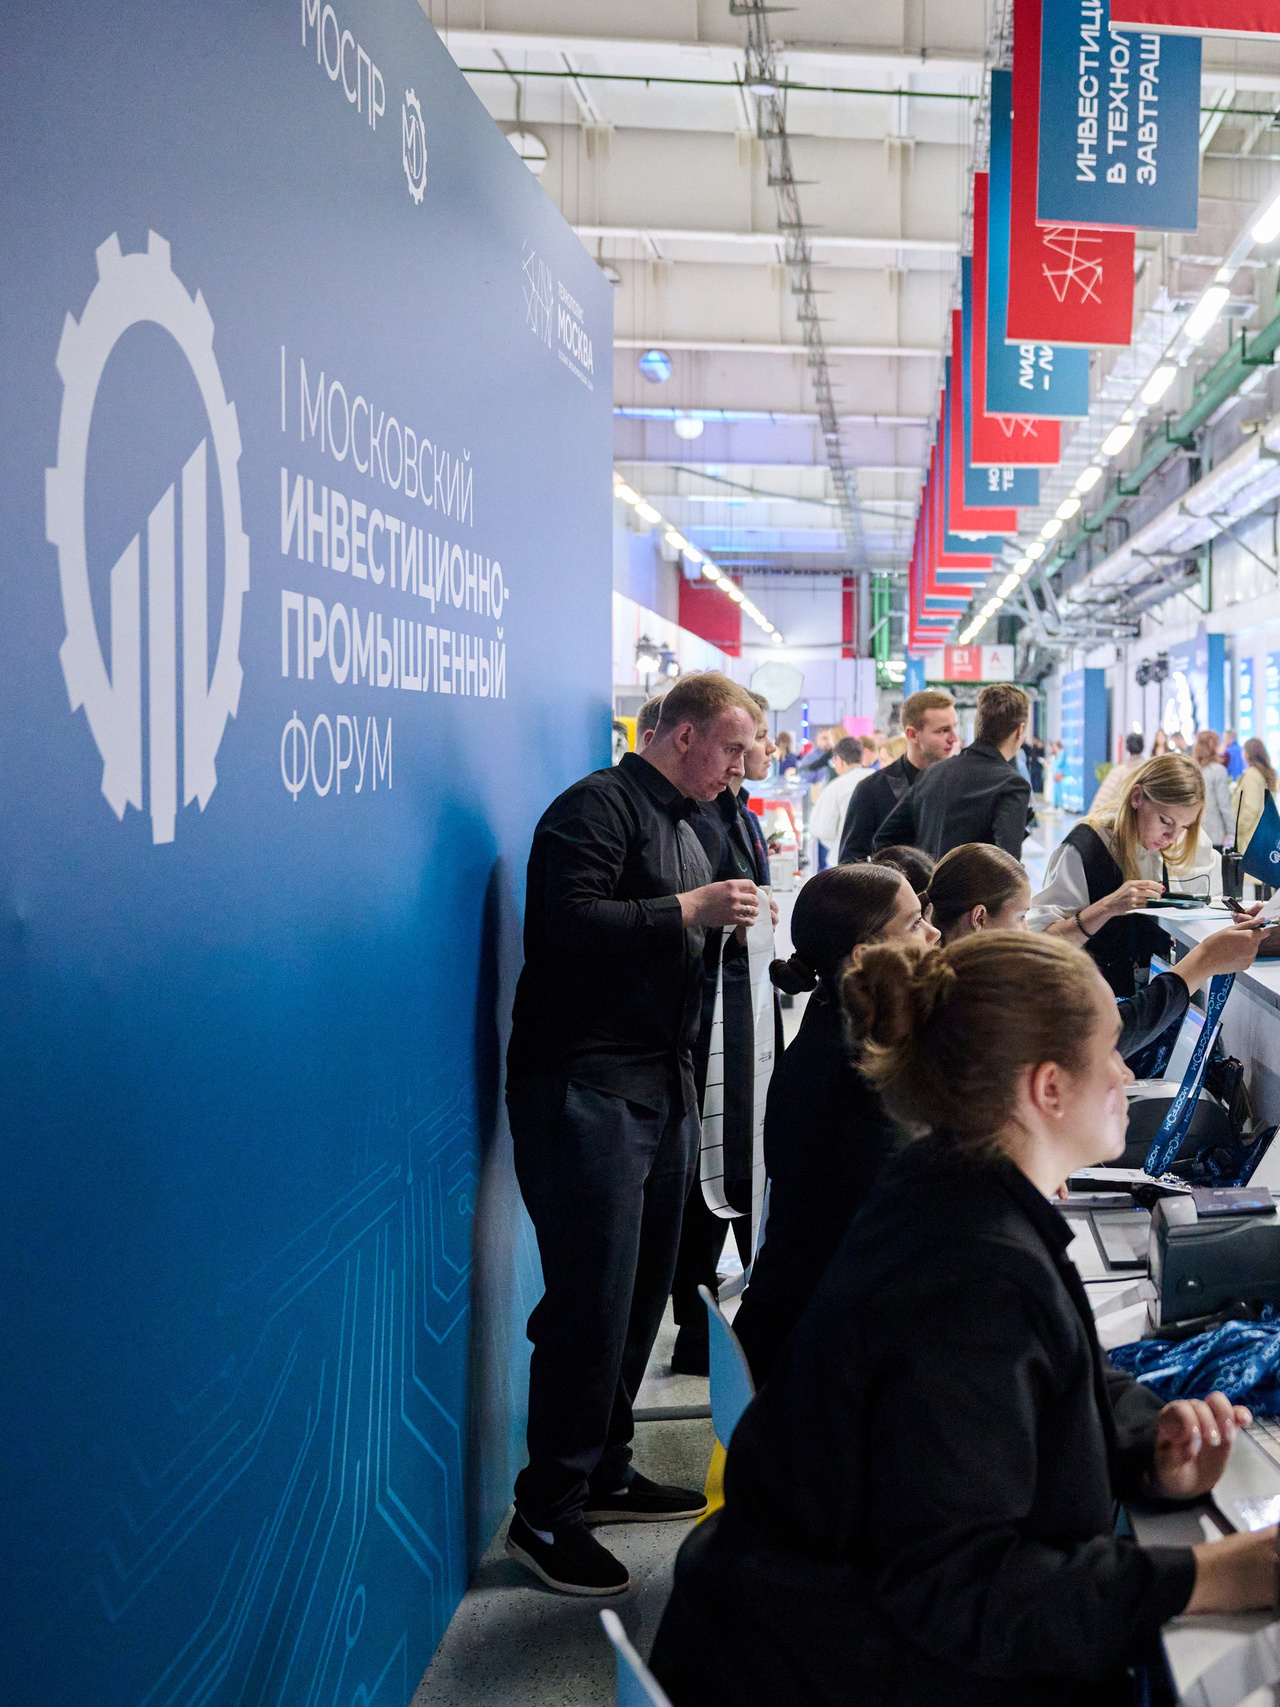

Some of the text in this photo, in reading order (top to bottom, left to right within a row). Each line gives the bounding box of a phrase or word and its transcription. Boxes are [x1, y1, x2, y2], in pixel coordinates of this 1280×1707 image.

[1136, 34, 1161, 186] ЗАВТРАШ
[1106, 162, 1127, 184] В
[558, 303, 594, 375] МОСКВА
[300, 357, 474, 527] МОСКОВСКИЙ
[281, 466, 509, 620] ИНВЕСТИЦИОННО-
[281, 590, 507, 699] ПРОМЫШЛЕННЫЙ
[280, 709, 393, 802] ФОРУМ
